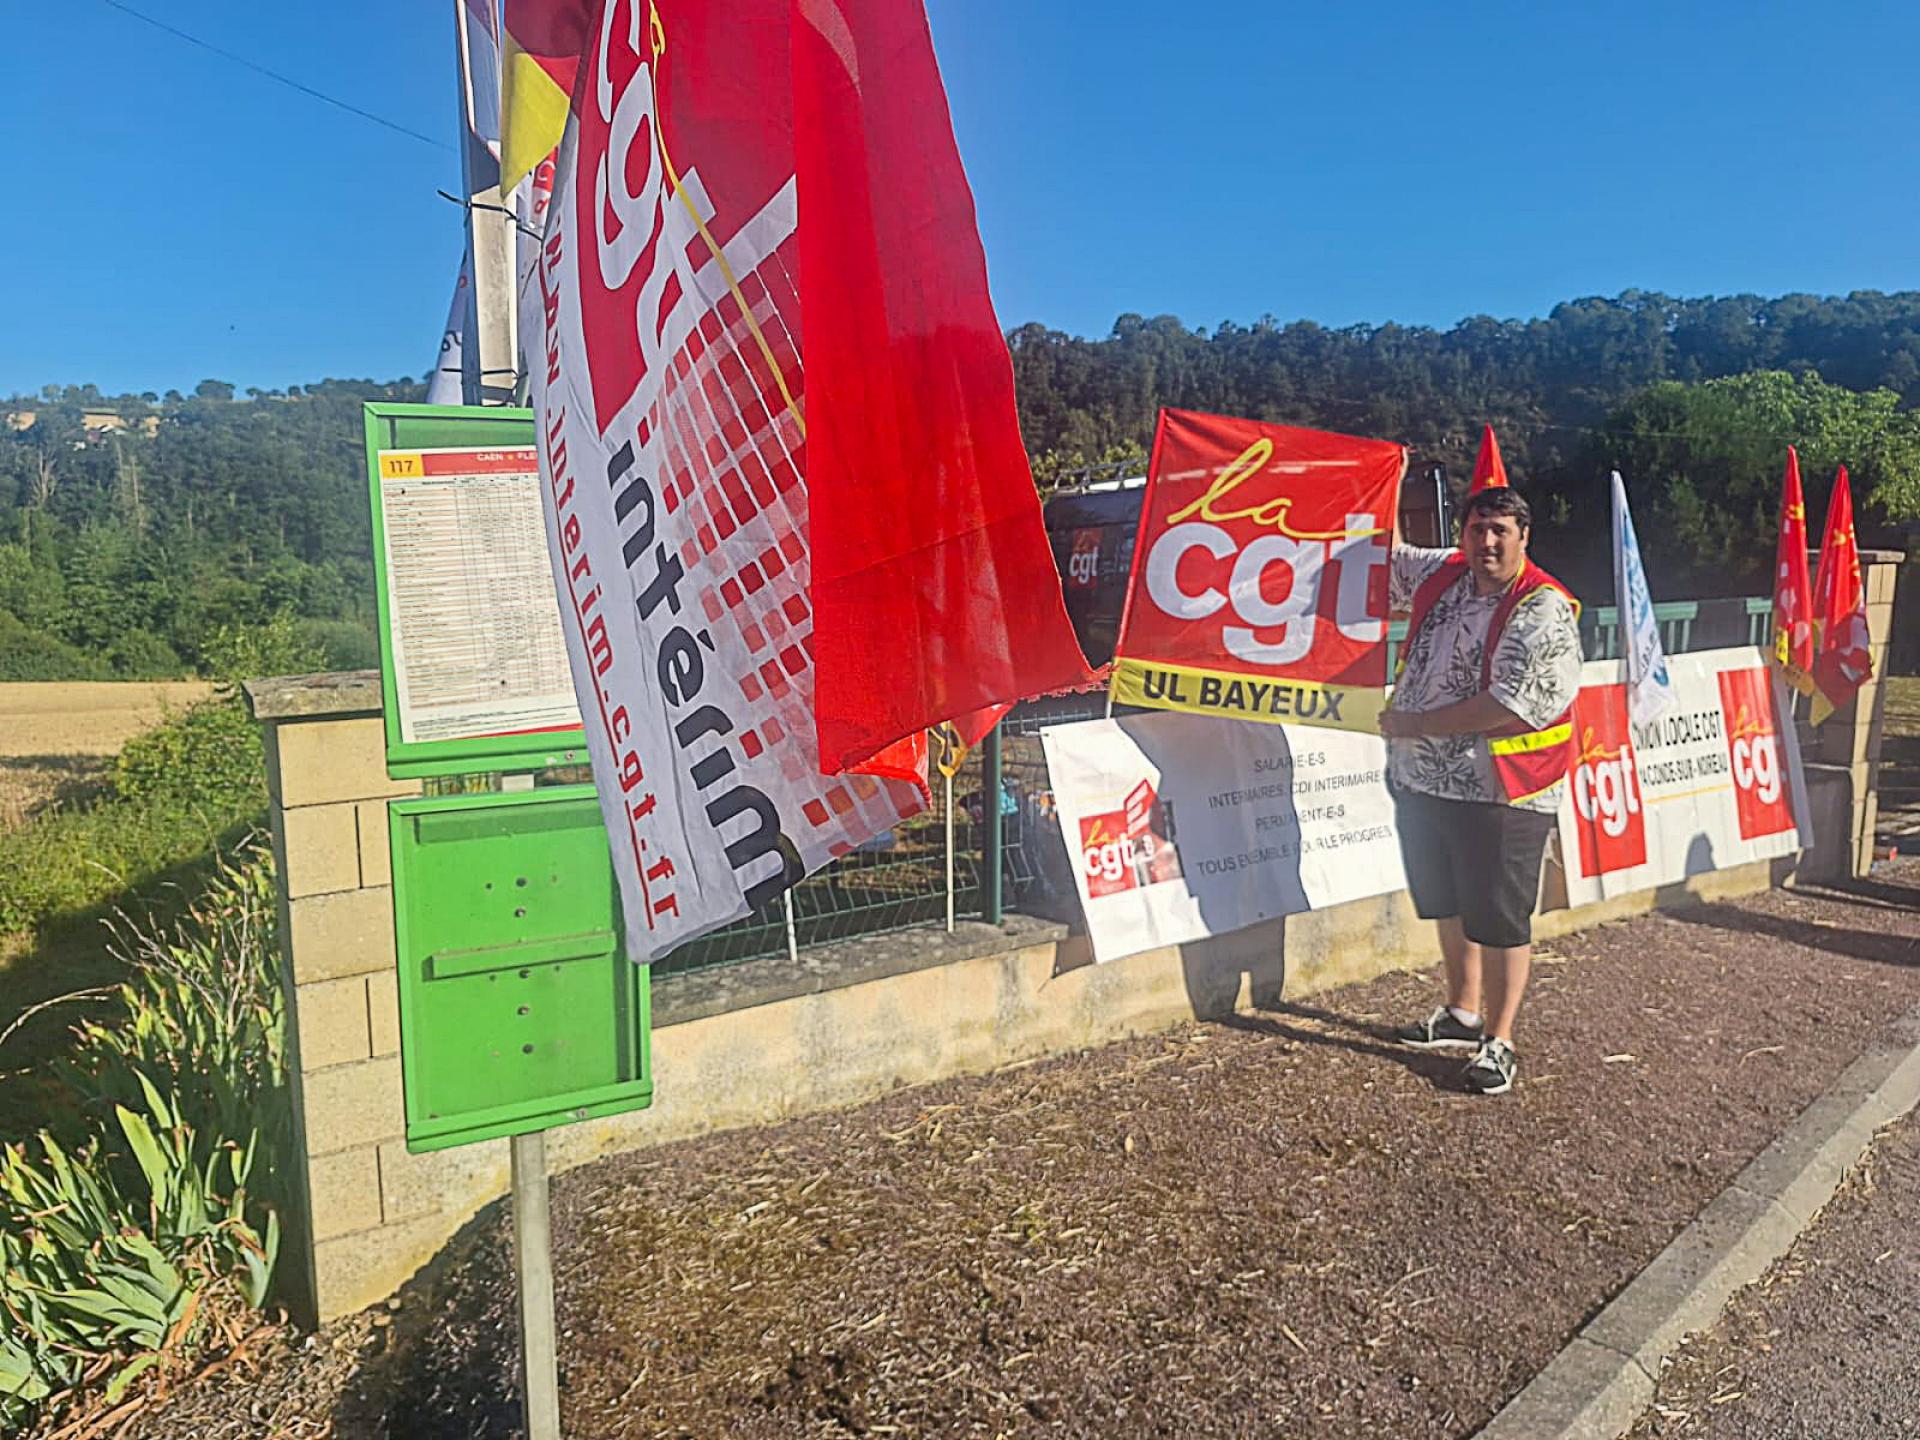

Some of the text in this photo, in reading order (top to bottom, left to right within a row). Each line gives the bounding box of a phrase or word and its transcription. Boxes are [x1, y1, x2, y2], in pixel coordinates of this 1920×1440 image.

[389, 460, 413, 473] 117
[1167, 438, 1386, 538] la
[1069, 546, 1099, 584] cgt
[1146, 513, 1387, 665] cgt
[607, 438, 805, 907] intérim
[1142, 670, 1344, 721] UL BAYEUX
[1664, 713, 1701, 746] LOCALE
[1702, 710, 1722, 740] CGT
[1574, 744, 1640, 837] cgt
[1733, 735, 1781, 804] cg
[1084, 832, 1136, 881] cgt
[1197, 858, 1237, 876] TOUS
